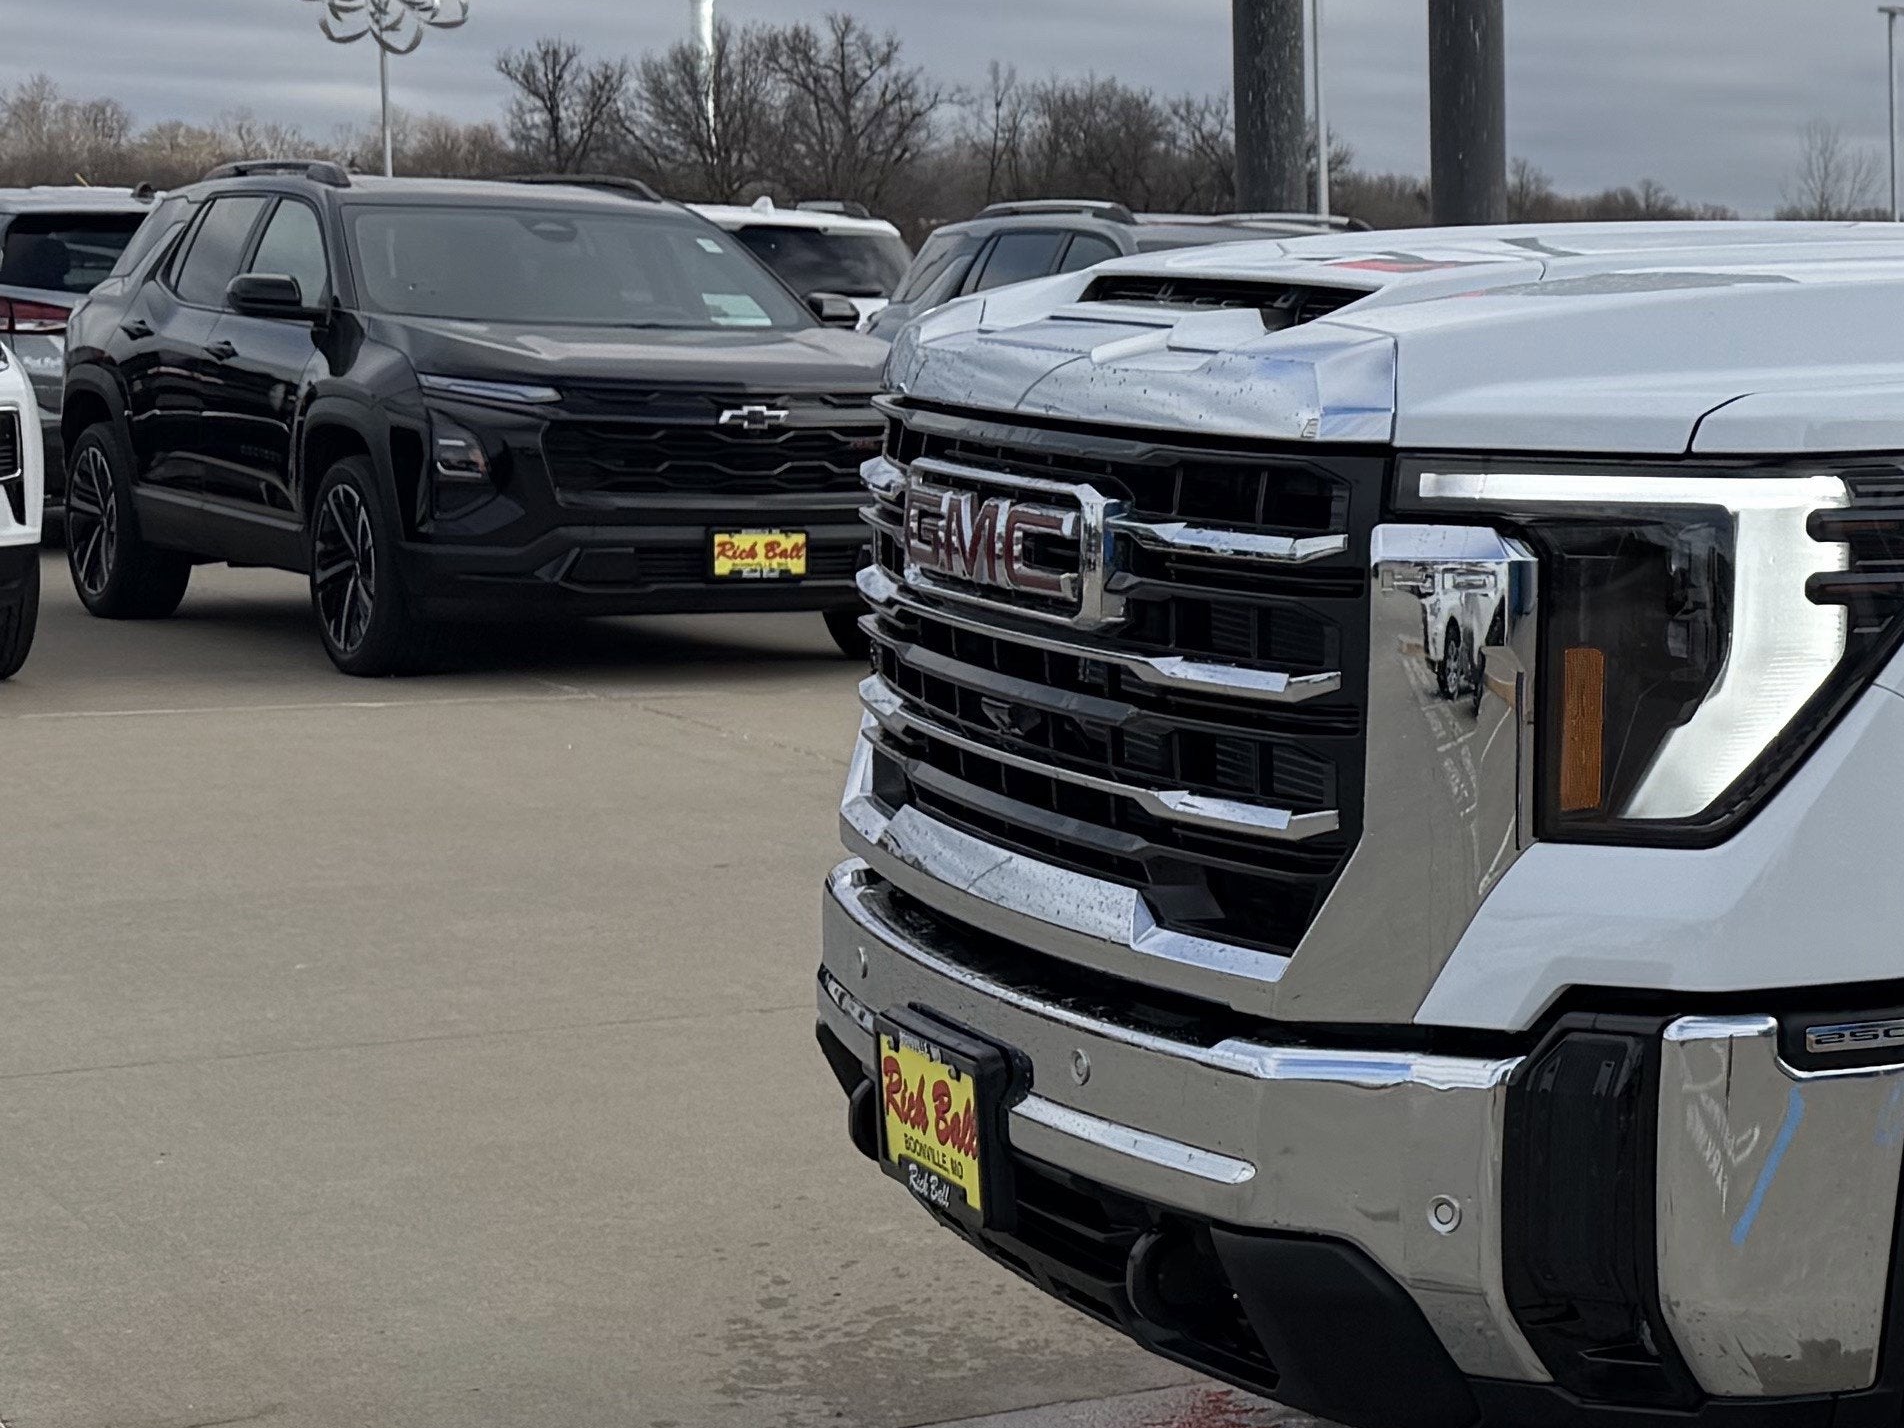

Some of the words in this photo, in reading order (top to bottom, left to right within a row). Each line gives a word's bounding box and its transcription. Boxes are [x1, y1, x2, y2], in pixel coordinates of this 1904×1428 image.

[716, 540, 758, 561] Rick
[764, 539, 806, 561] Ball
[904, 488, 1082, 603] GMC
[883, 1055, 929, 1136] Rick
[932, 1079, 979, 1161] Ball
[903, 1132, 950, 1174] BOONVILLE
